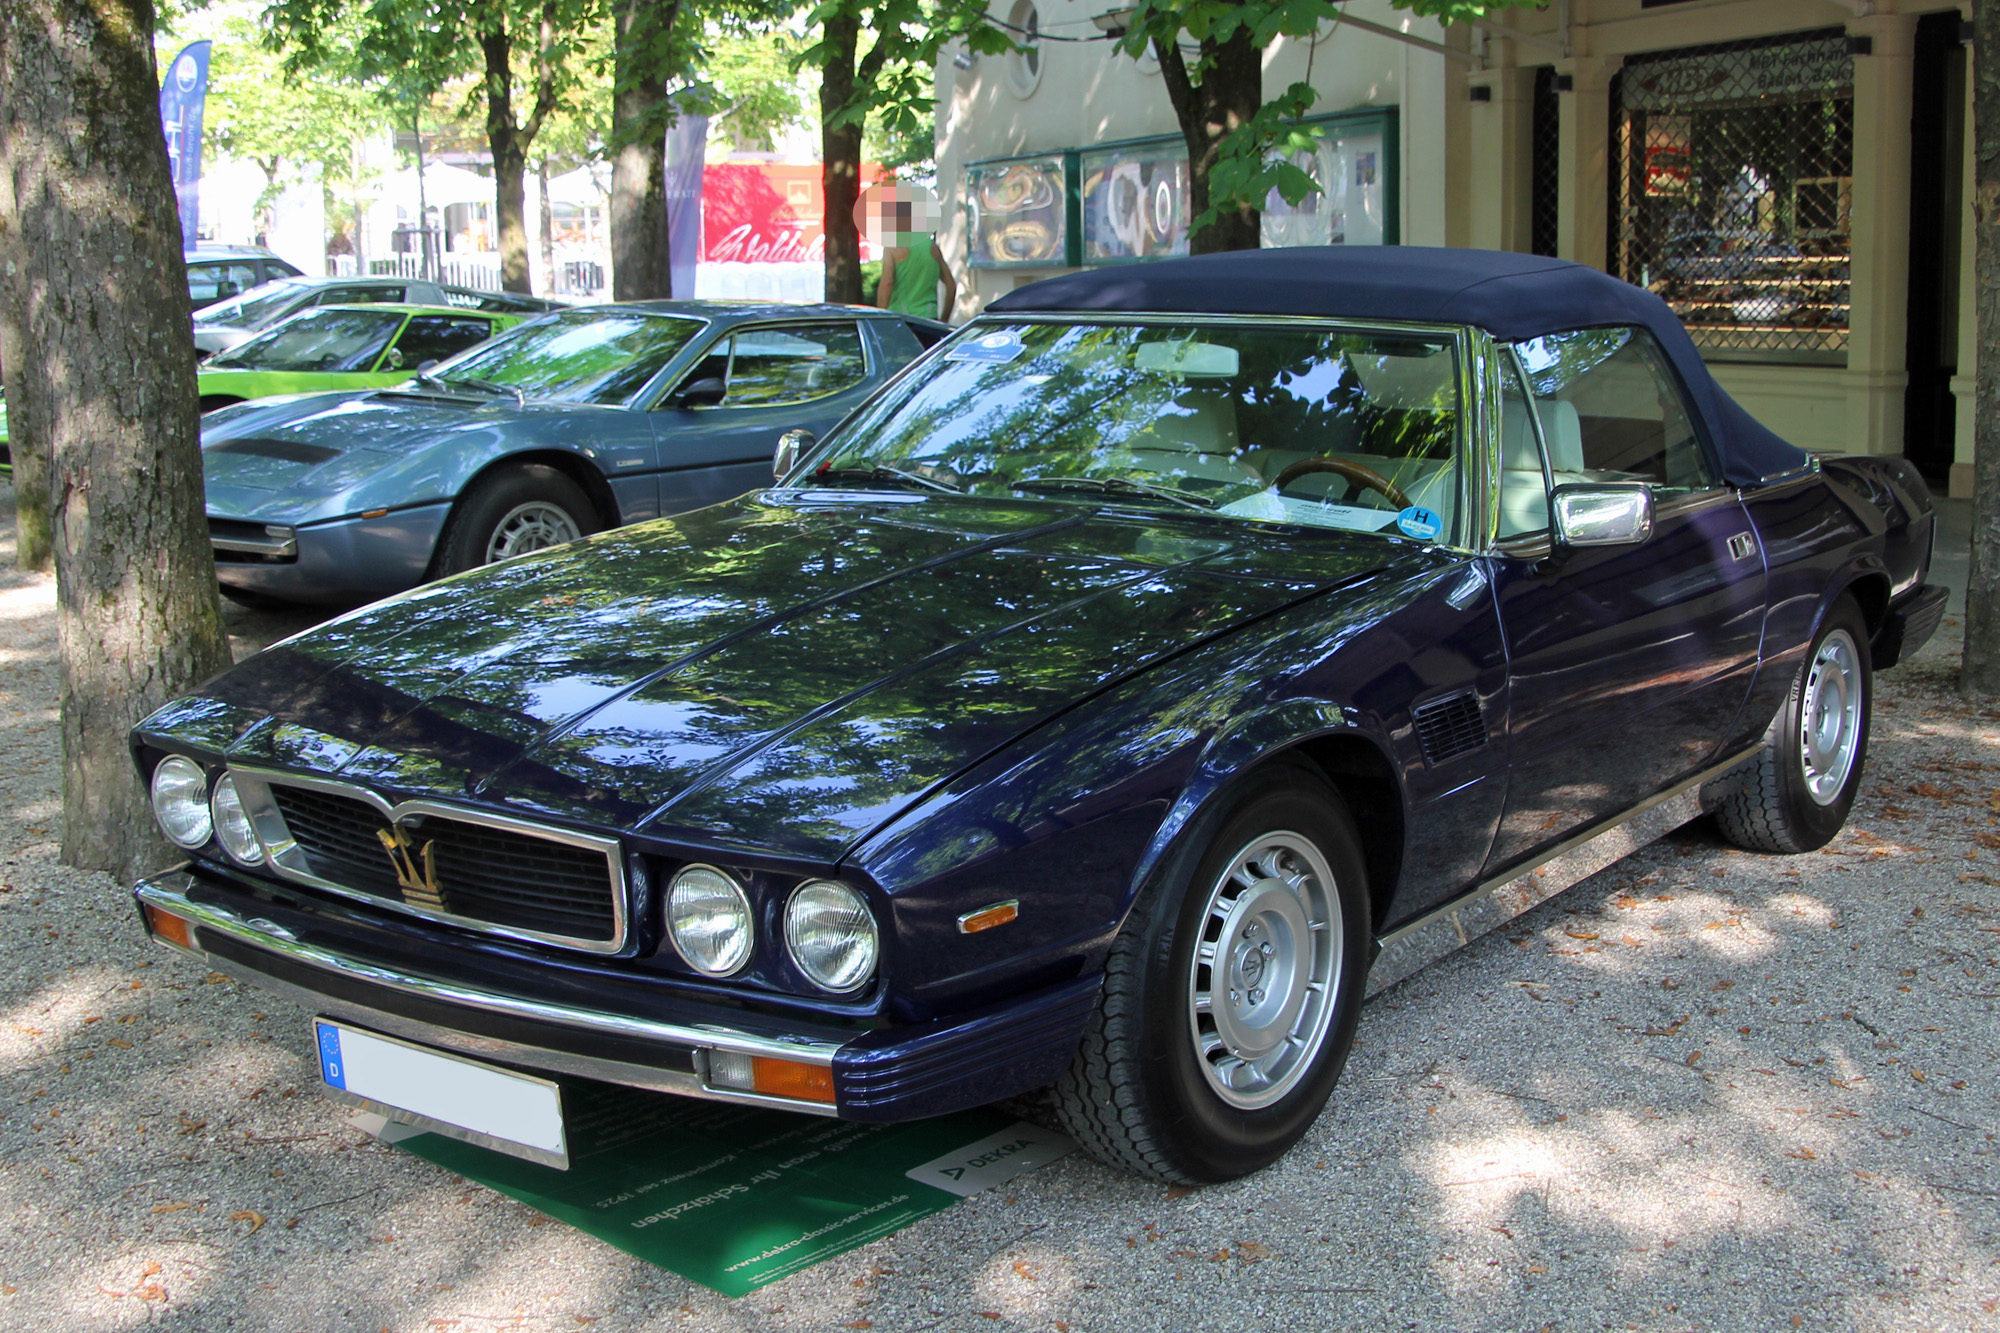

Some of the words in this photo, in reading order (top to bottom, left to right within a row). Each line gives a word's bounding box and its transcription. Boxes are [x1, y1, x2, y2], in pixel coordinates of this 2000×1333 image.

[1414, 510, 1429, 523] H
[329, 1062, 339, 1078] D
[777, 1151, 821, 1169] man
[967, 1138, 1035, 1169] DEKRA
[750, 1169, 781, 1185] Ihr
[591, 1191, 635, 1208] 1925.
[631, 1183, 750, 1229] Schätzchen
[724, 1194, 910, 1272] www.dekra-classic-services.de
